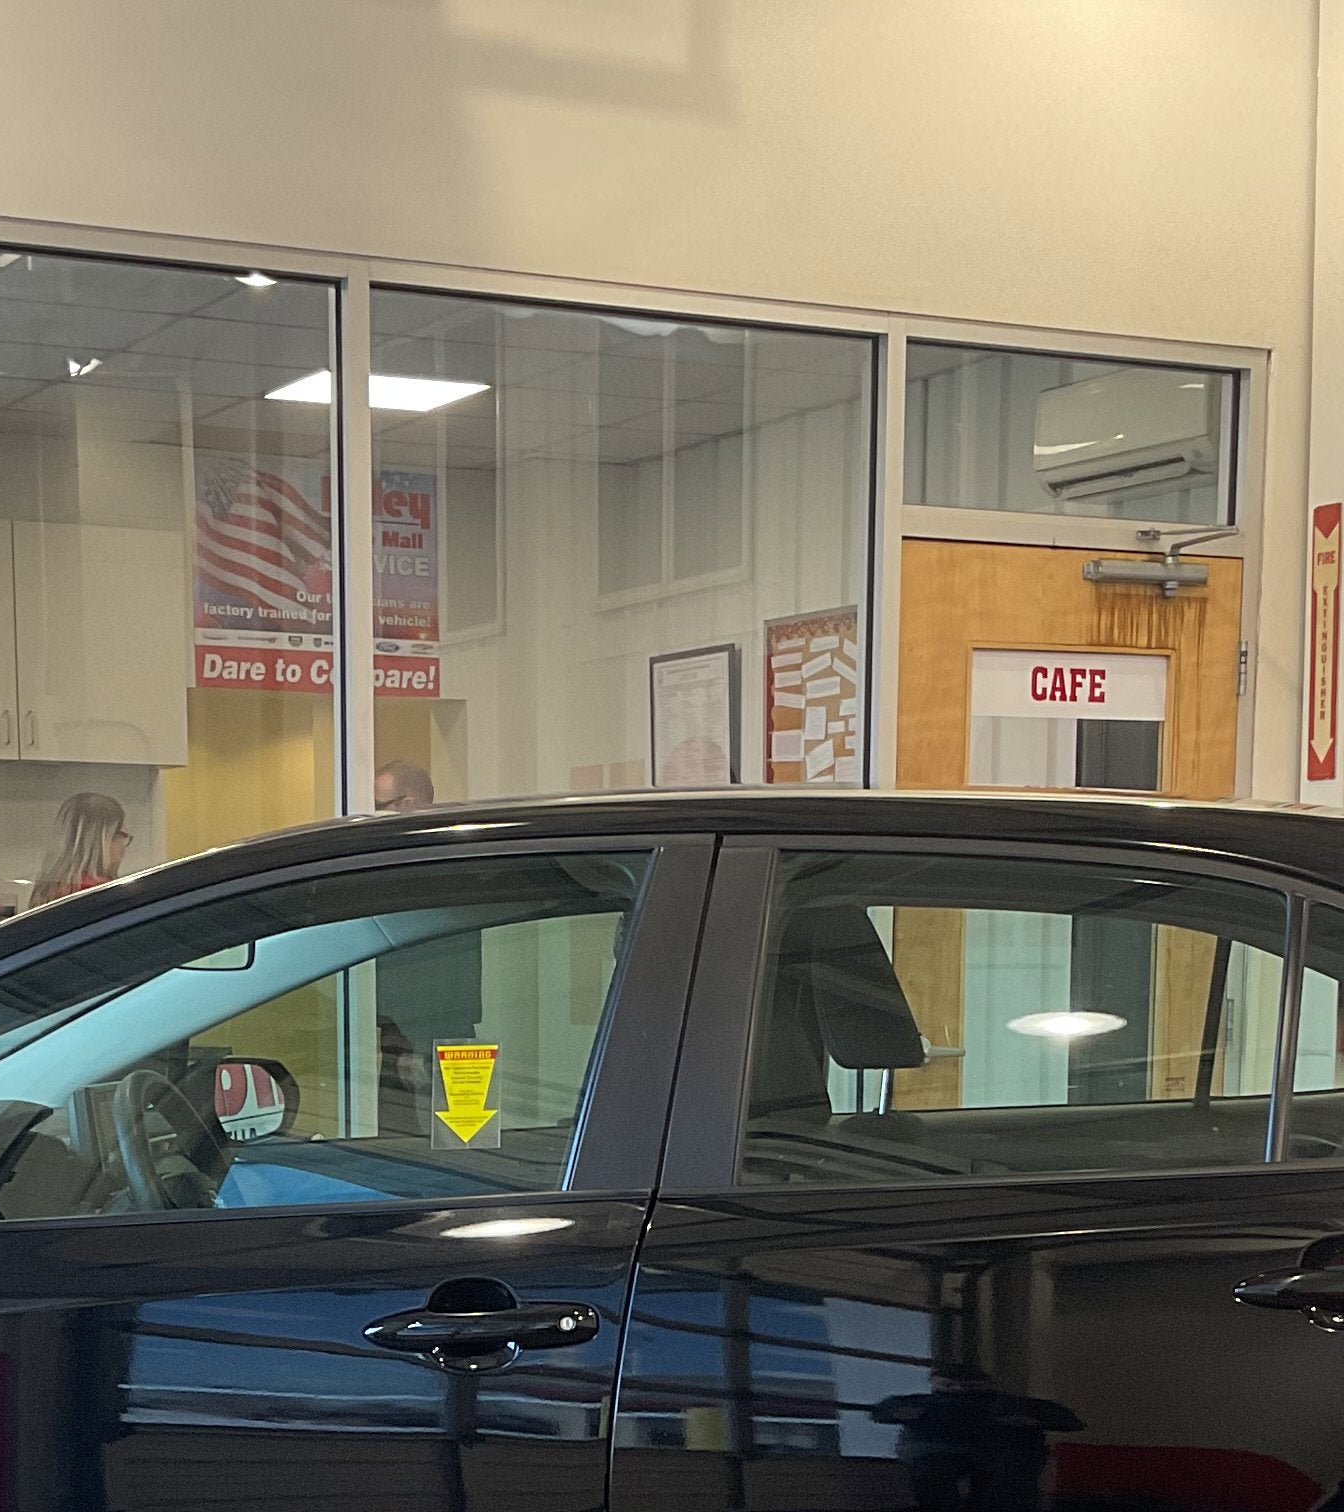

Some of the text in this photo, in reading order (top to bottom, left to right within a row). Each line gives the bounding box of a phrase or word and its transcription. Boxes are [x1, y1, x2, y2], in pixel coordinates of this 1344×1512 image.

[382, 531, 423, 550] Mall
[1317, 551, 1336, 566] FIRE
[297, 591, 322, 604] Our
[204, 603, 254, 619] factory
[258, 606, 307, 620] trained
[309, 608, 332, 625] for
[1319, 585, 1329, 721] EXTINGUISHER
[203, 653, 266, 681] Dare
[275, 658, 302, 684] to
[1030, 665, 1106, 704] CAFE
[444, 1050, 492, 1060] WARNING
